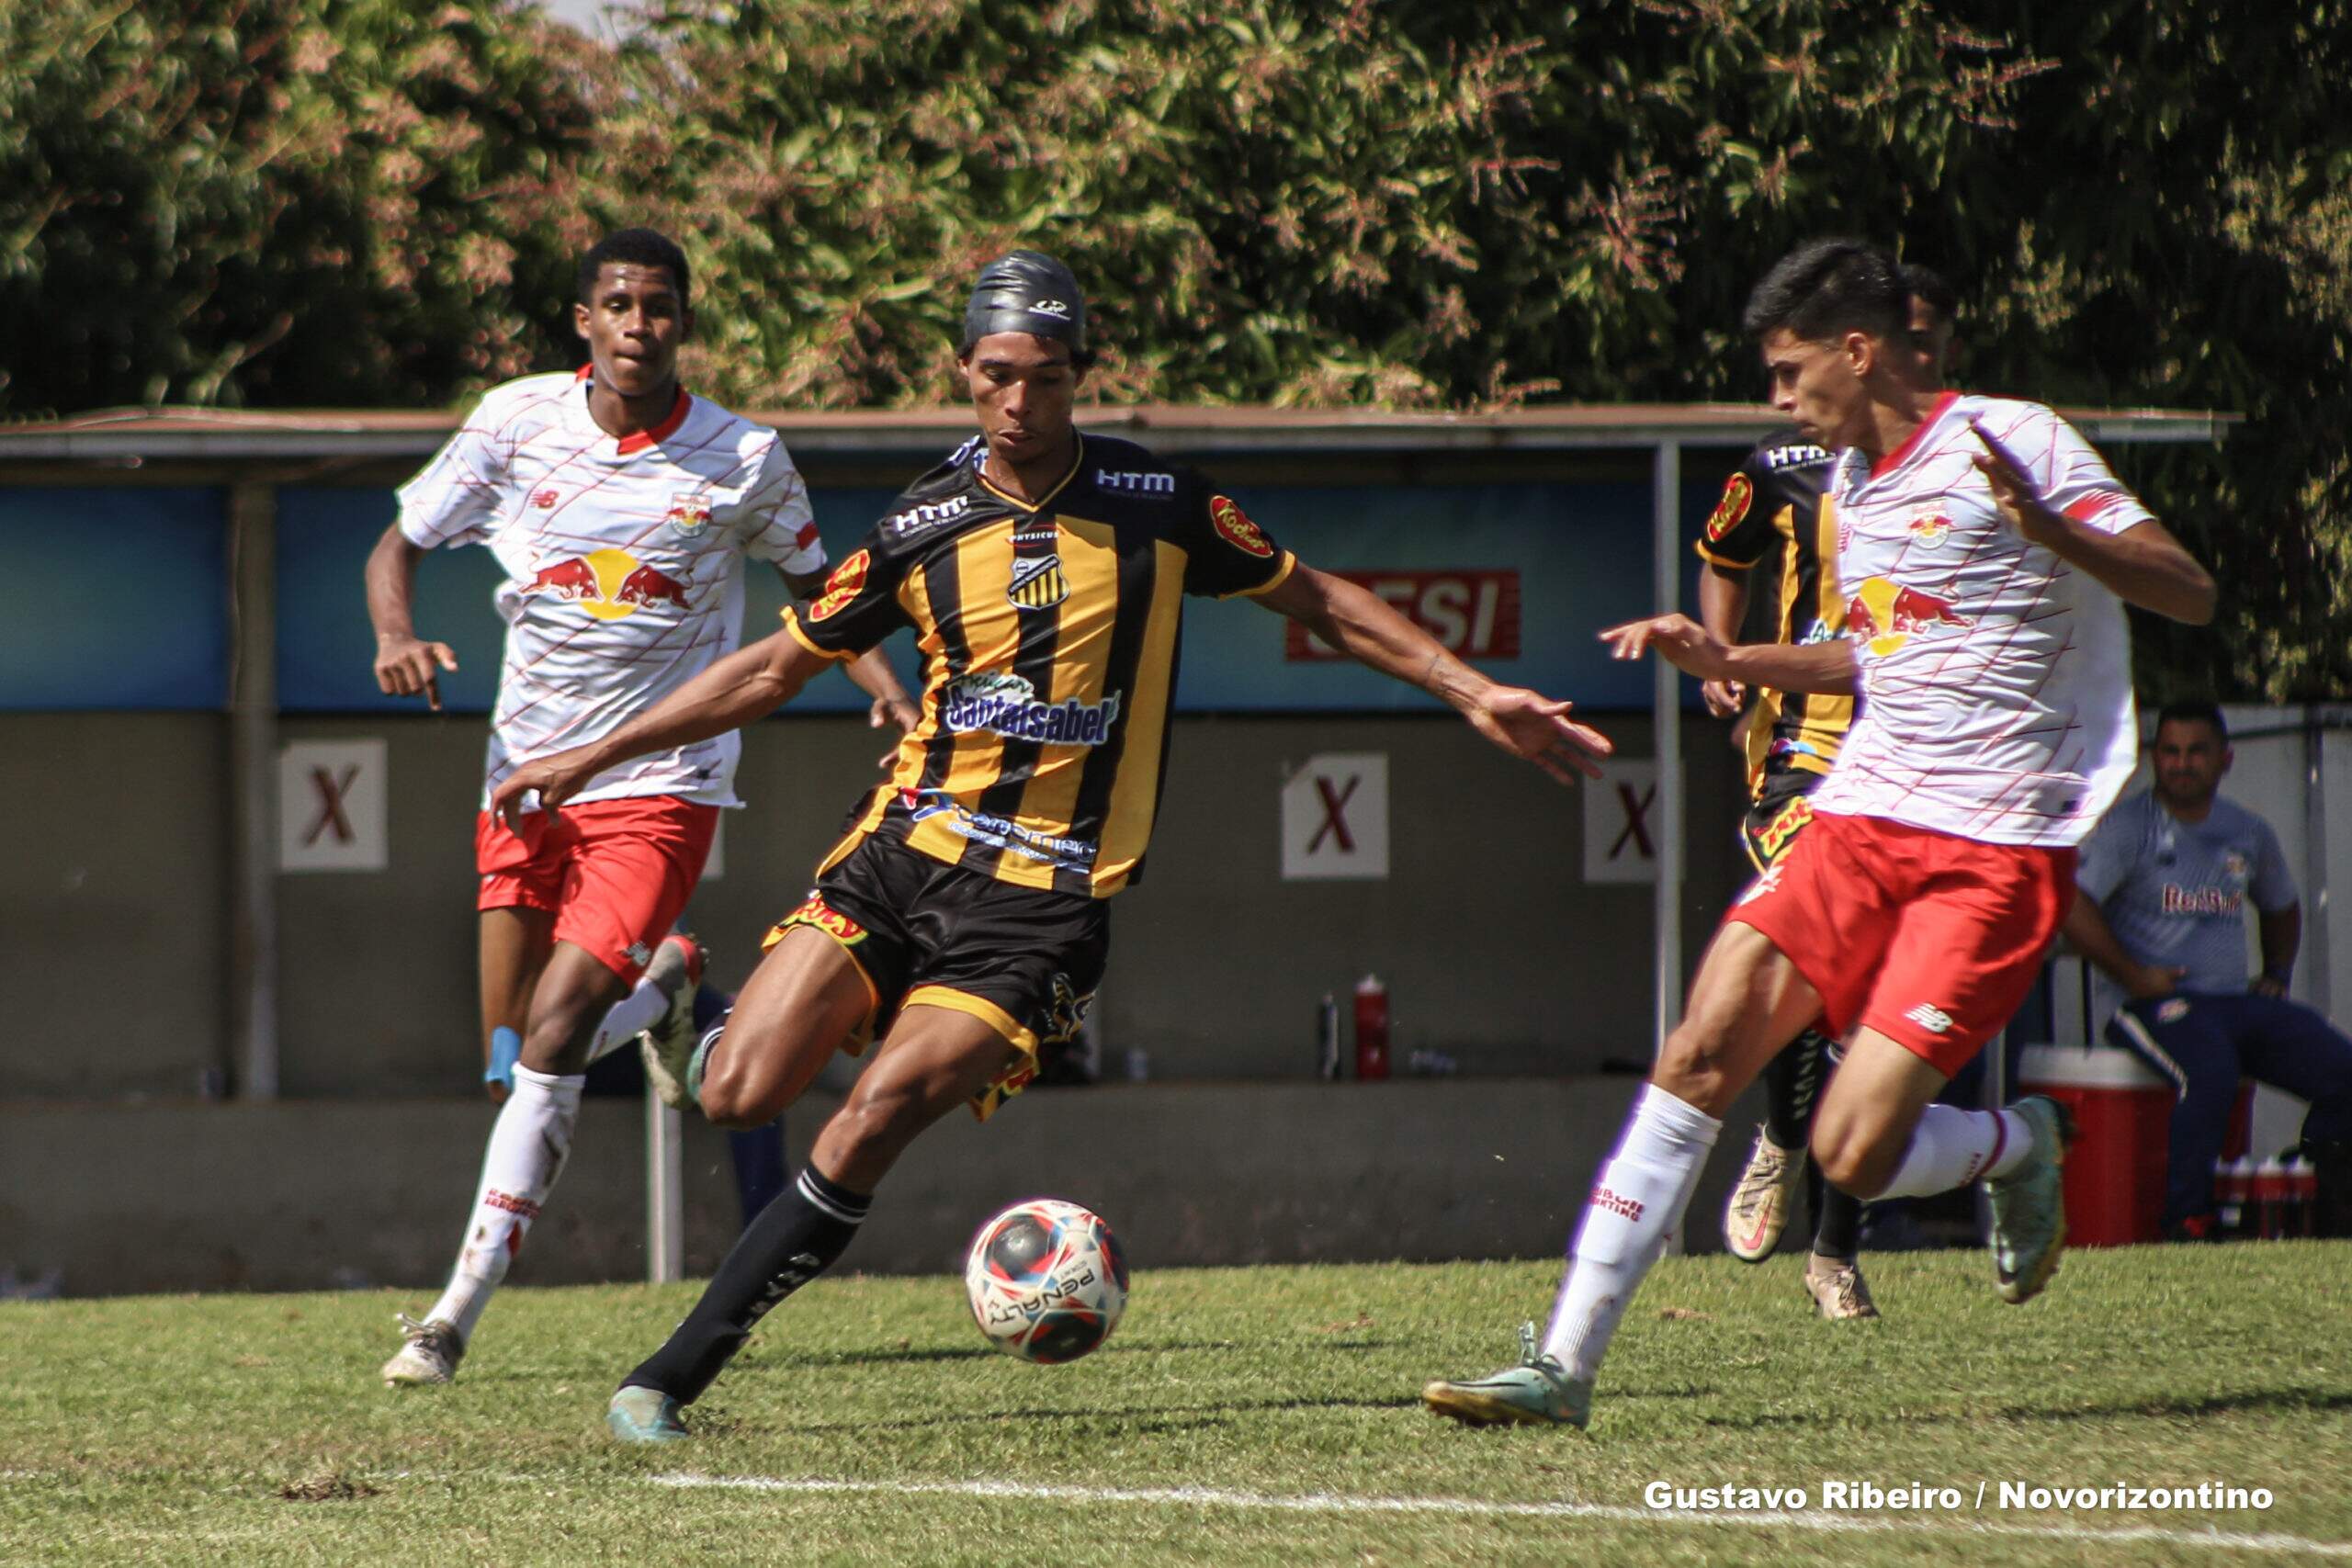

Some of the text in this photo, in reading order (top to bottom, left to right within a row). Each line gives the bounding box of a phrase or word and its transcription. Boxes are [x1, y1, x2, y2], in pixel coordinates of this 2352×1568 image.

[1096, 468, 1175, 492] HTM
[896, 496, 968, 532] HTM
[1306, 774, 1361, 855] X
[990, 1269, 1095, 1325] PENALTY
